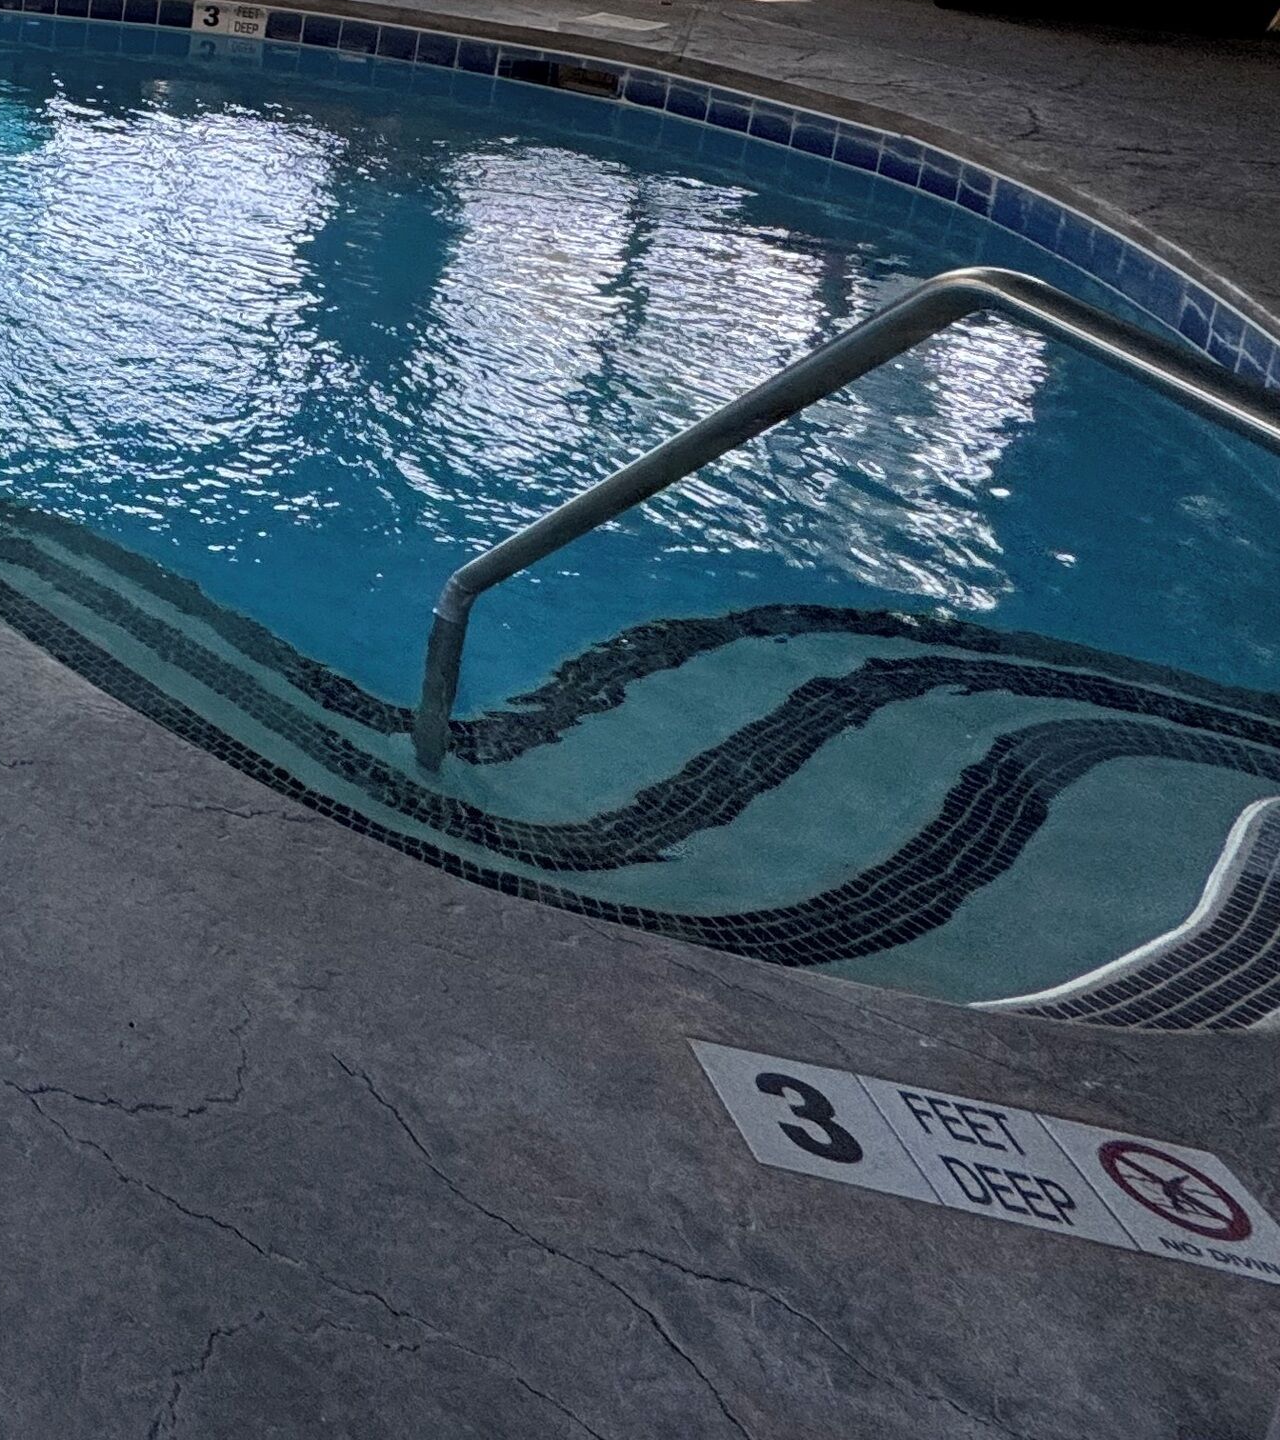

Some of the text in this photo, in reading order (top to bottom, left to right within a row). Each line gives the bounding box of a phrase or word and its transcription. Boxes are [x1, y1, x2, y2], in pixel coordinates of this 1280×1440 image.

[202, 5, 220, 27] 3
[236, 6, 261, 20] FEET
[233, 20, 259, 35] DEEP
[755, 1072, 864, 1164] 3
[896, 1088, 1026, 1157] FEET
[938, 1154, 1077, 1226] DEEP
[1158, 1236, 1203, 1258] NO
